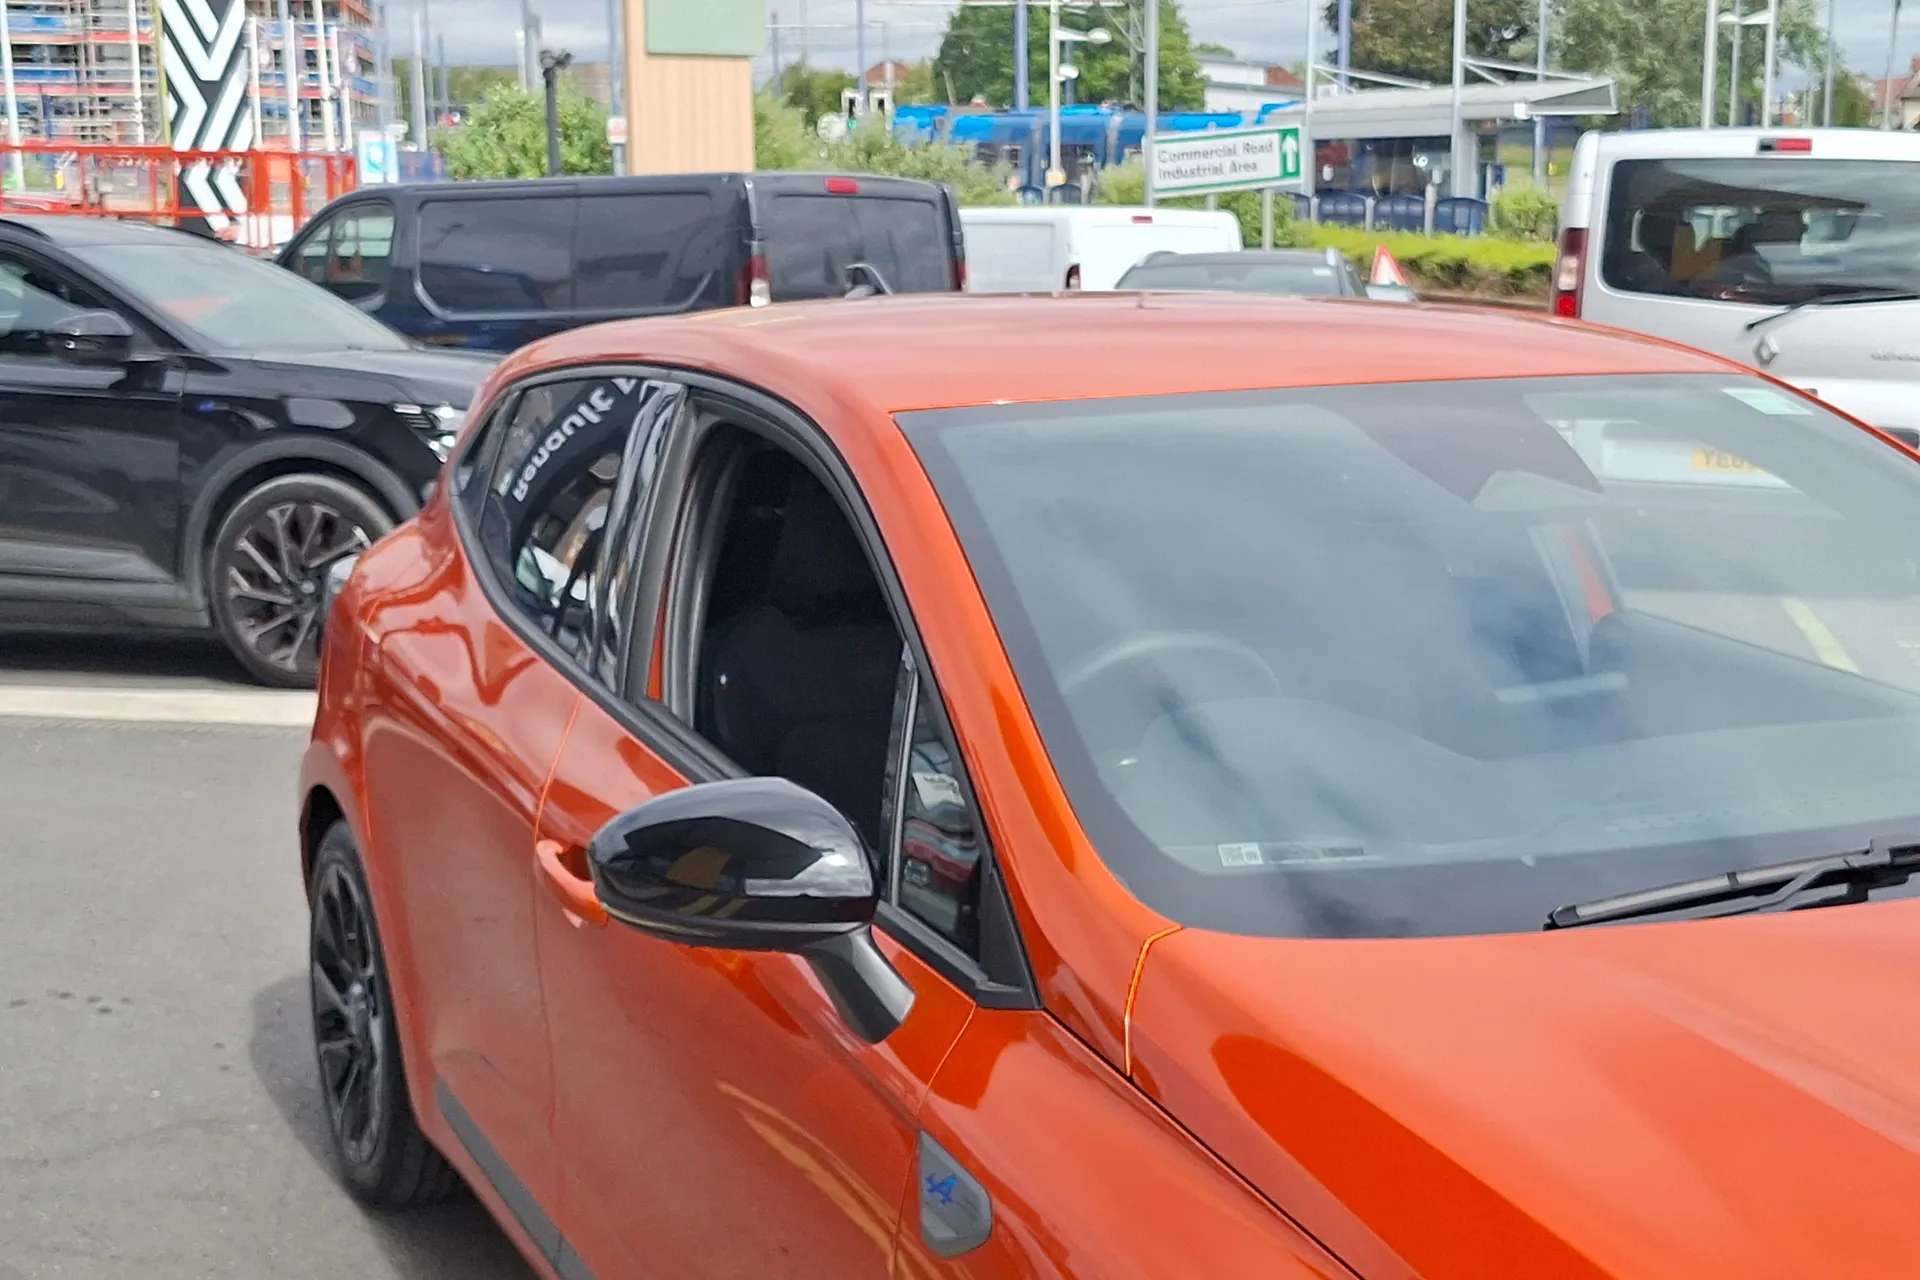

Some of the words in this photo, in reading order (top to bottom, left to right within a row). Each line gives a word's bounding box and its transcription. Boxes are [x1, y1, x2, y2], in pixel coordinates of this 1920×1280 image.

[1158, 144, 1237, 163] Commercial
[1242, 141, 1273, 154] Road
[1158, 164, 1224, 180] Industrial
[1230, 161, 1257, 174] Area
